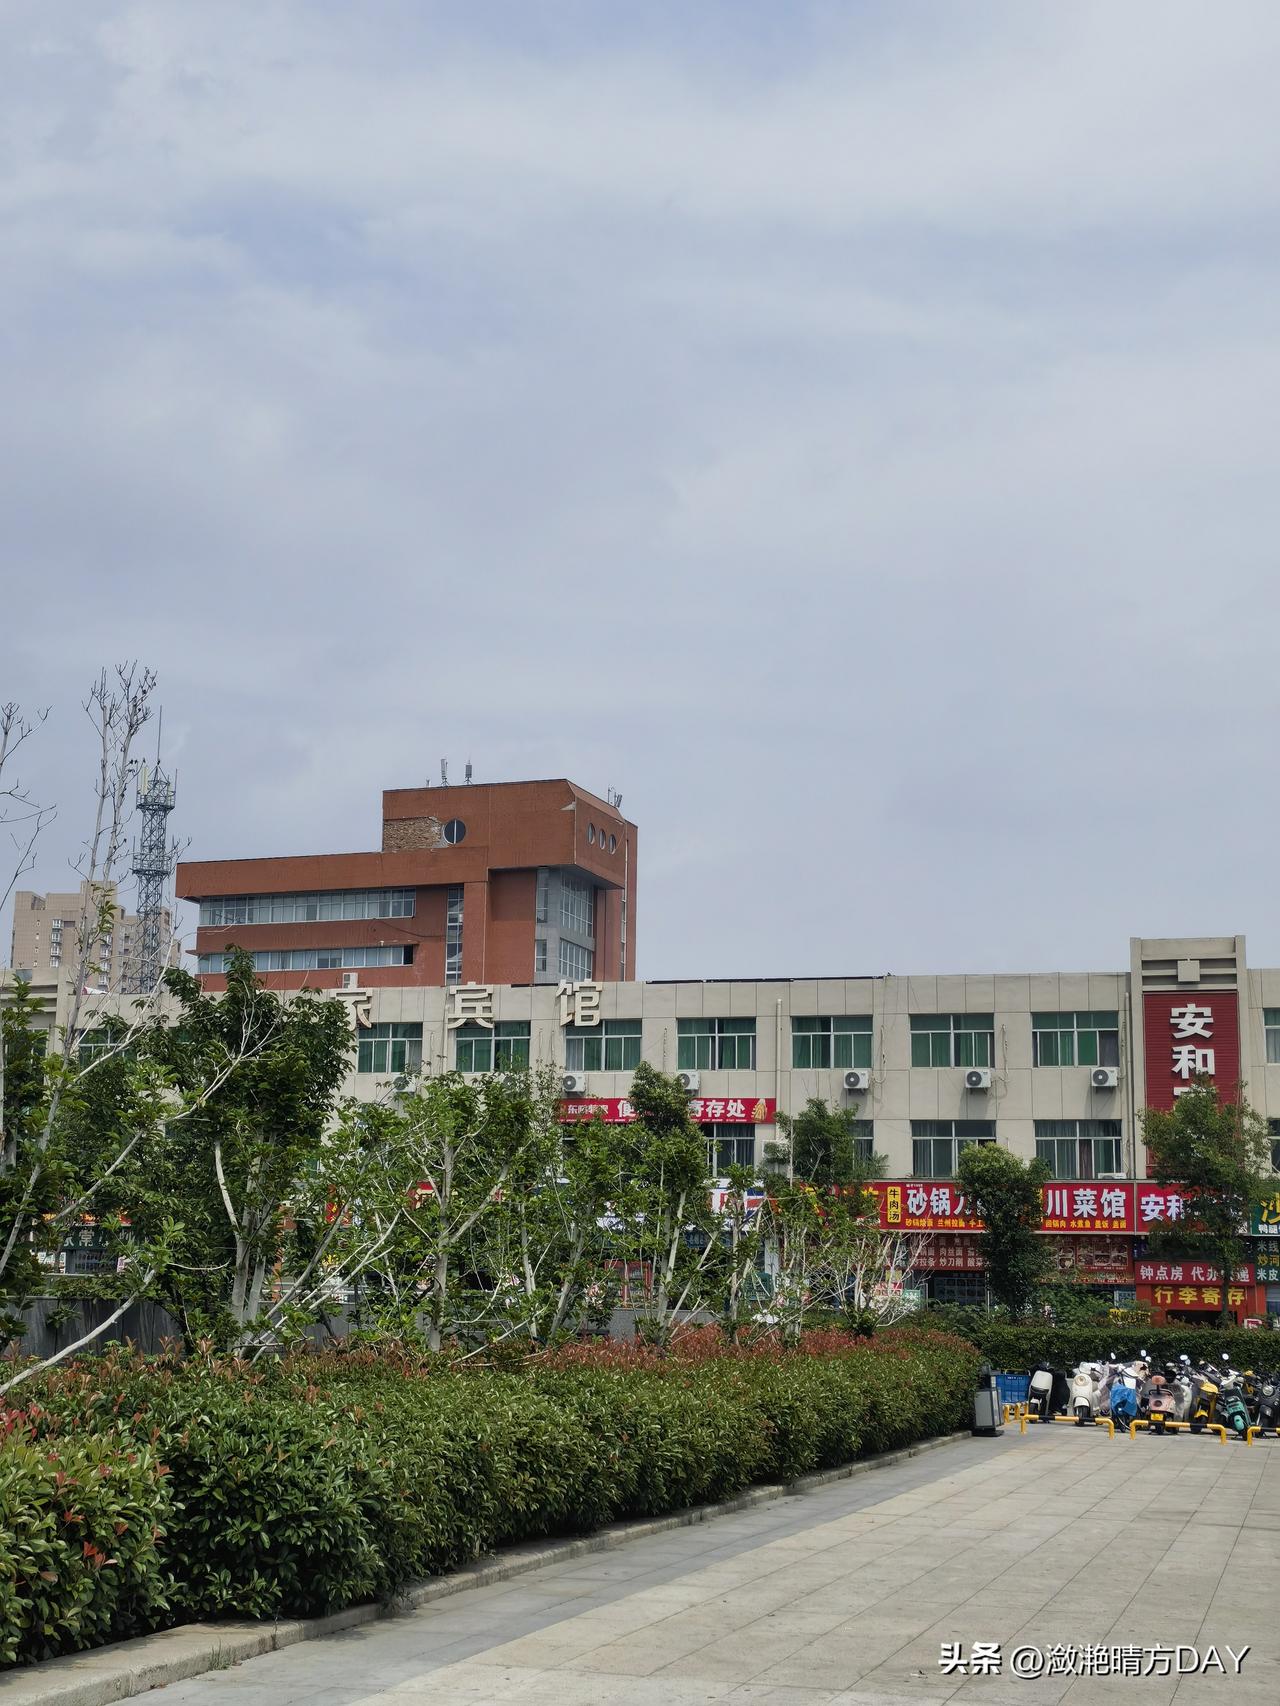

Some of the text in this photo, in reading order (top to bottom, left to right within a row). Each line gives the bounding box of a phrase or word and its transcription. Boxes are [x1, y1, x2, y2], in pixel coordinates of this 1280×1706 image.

[889, 1189, 900, 1221] 牛肉汤
[1046, 1188, 1127, 1218] 川菜馆
[1140, 1265, 1250, 1282] 钟点房 代办递
[1154, 1286, 1245, 1306] 行李寄存
